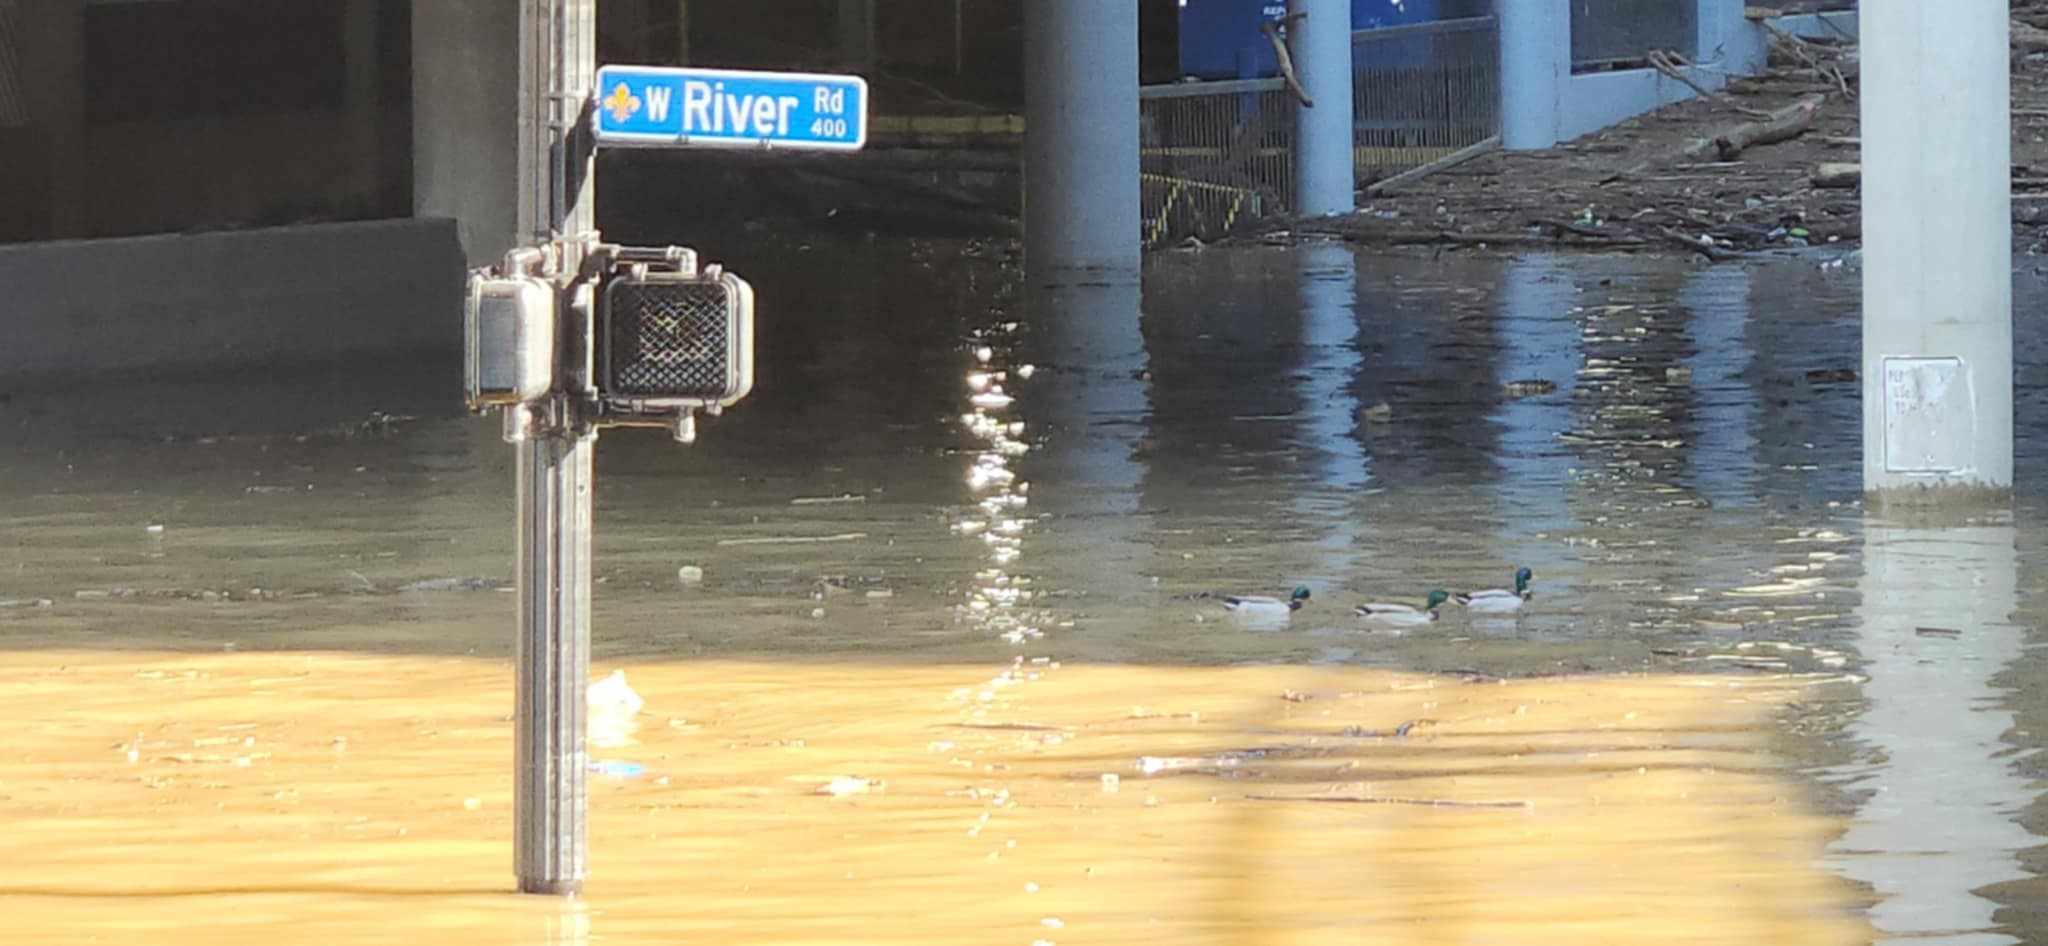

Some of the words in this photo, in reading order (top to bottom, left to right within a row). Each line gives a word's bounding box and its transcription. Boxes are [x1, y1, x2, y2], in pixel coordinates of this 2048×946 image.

[646, 86, 671, 122] W
[683, 80, 799, 136] River
[813, 86, 845, 114] Rd
[811, 118, 846, 138] 400
